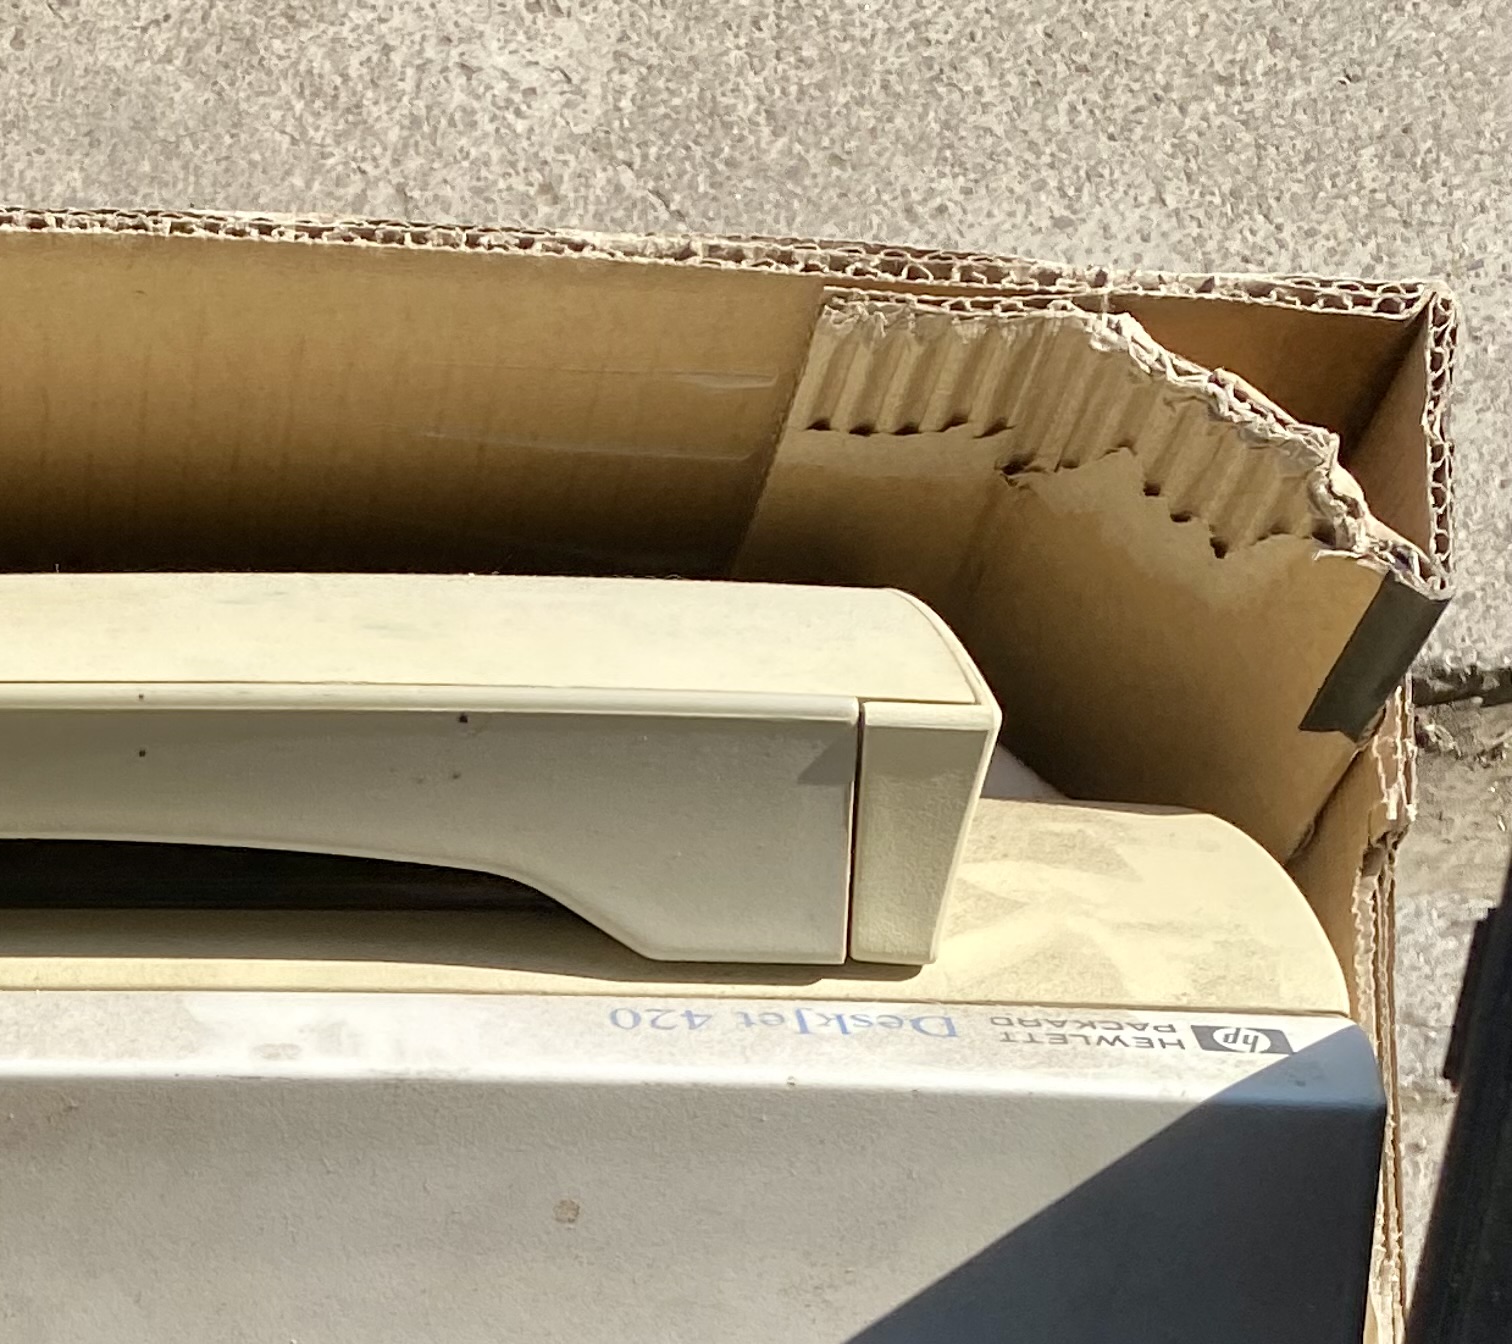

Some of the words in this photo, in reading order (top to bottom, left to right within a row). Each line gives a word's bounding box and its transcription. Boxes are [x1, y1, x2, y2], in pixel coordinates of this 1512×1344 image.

[609, 1007, 713, 1031] 420
[736, 1007, 960, 1038] DeskJet
[990, 1016, 1177, 1033] PACKARD
[998, 1031, 1186, 1050] HEWLETT
[1222, 1026, 1260, 1054] hp
